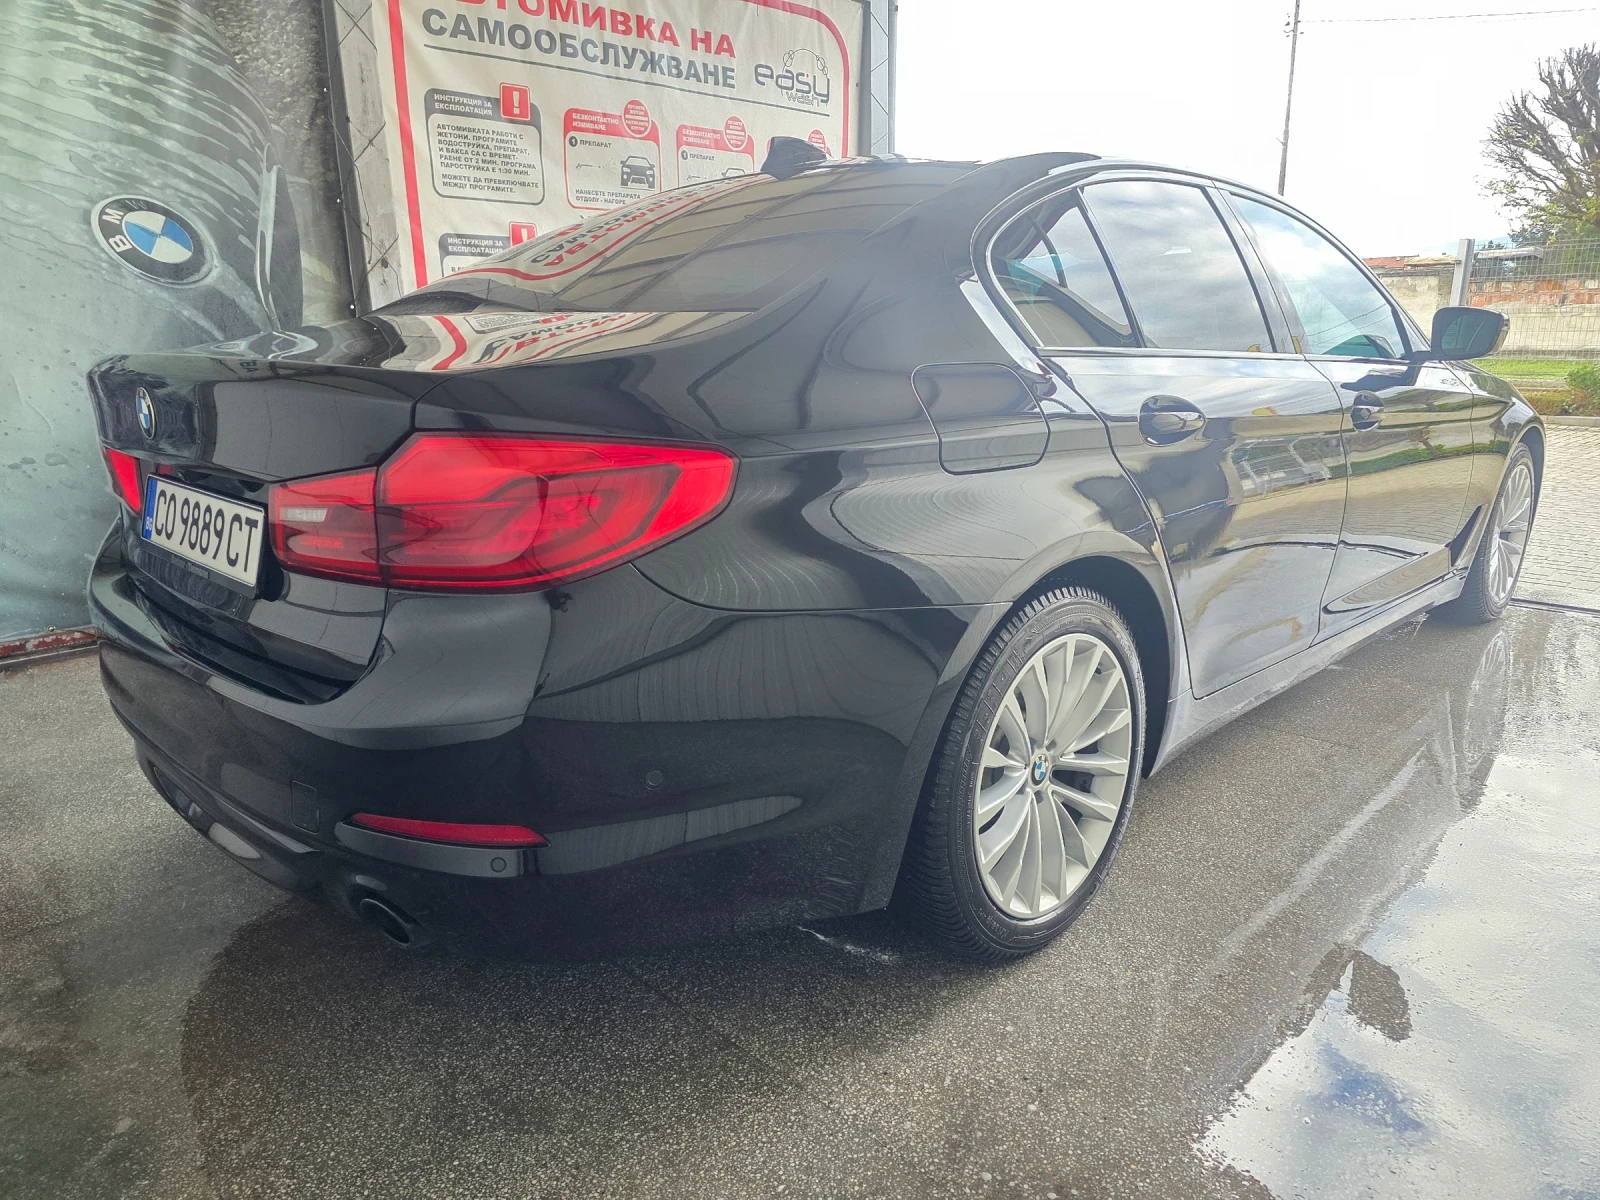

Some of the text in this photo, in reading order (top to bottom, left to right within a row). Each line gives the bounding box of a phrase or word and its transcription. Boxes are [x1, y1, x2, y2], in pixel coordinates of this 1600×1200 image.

[456, 0, 736, 58] ОМИВКА НА
[422, 8, 735, 89] САМООБСЛУЖВАНЕ
[754, 63, 830, 103] easy
[434, 93, 492, 108] ИНСТРУКЦИЯ ЗА
[434, 102, 493, 116] ЕКСПЛОАТАЦИЯ
[572, 112, 619, 125] БЕЗКОНТАКТНО
[436, 123, 490, 135] АВТОМИВКАТА
[491, 130, 518, 139] РАБОТИ
[472, 135, 518, 146] ПРОГРАМИТЕ
[579, 139, 612, 149] ПРЕПАРАТ
[445, 147, 469, 155] ВАКСА
[440, 161, 490, 173] ПАРОСТРУЙКА
[498, 167, 512, 175] 1:30
[500, 160, 537, 170] ПРОГРАМА
[441, 173, 539, 188] МОЖЕТЕ ДА ПРЕВКЛЮЧВАТЕ
[442, 181, 467, 189] МЕЖДУ
[575, 188, 641, 199] НАНЕСЕТЕ ПРЕПАРАТА
[447, 237, 493, 247] ИНСТРУКЦИЯ
[179, 497, 225, 560] 9889
